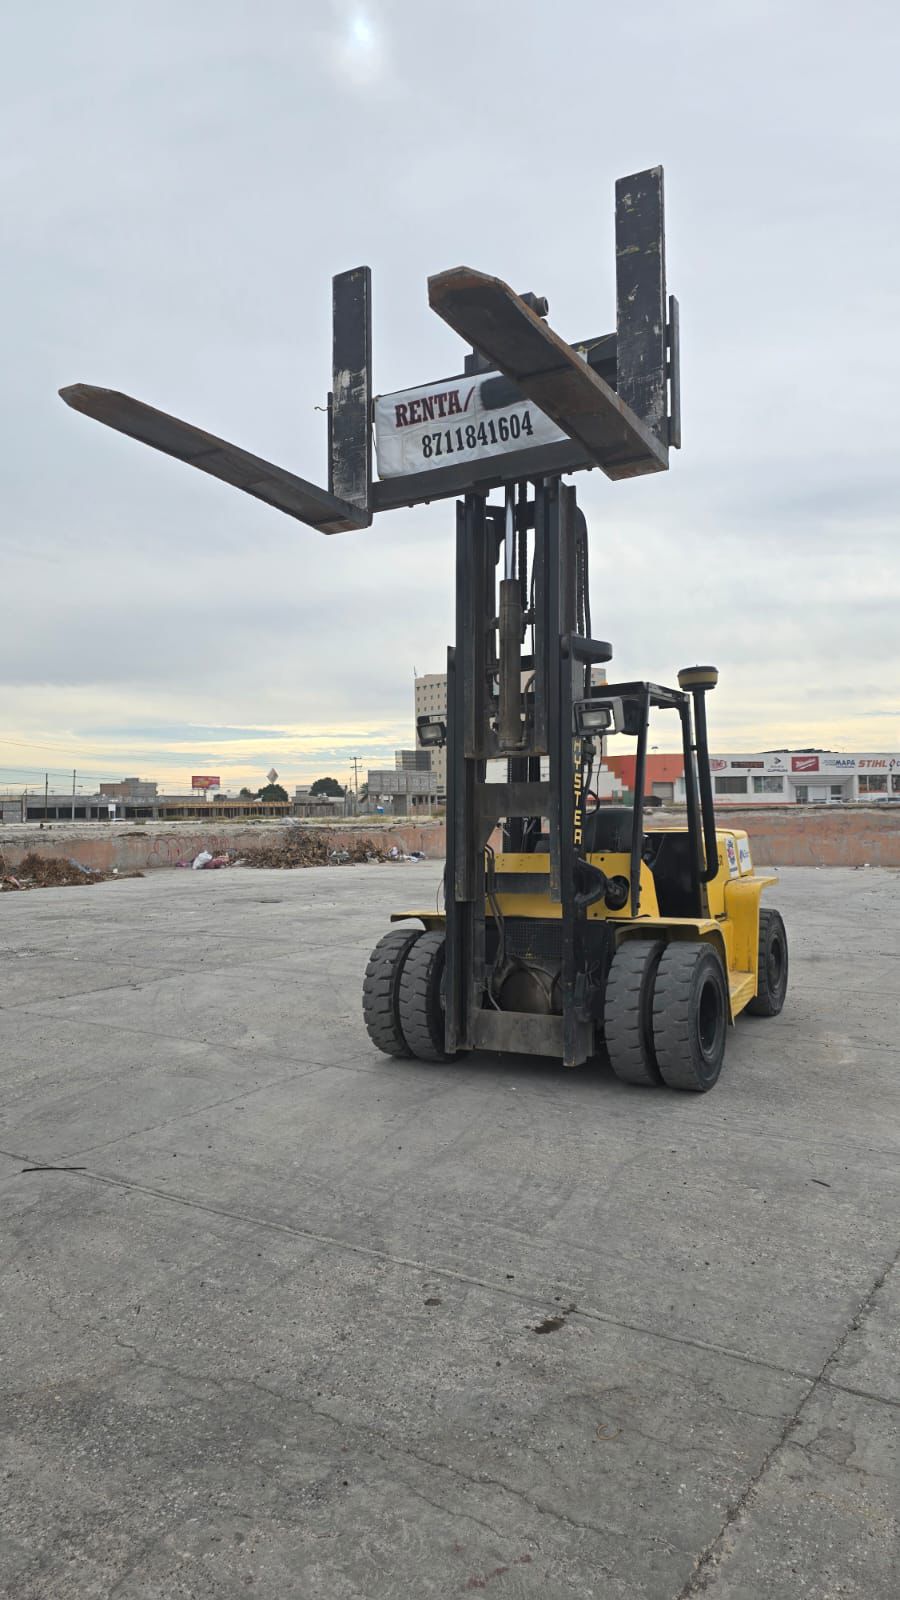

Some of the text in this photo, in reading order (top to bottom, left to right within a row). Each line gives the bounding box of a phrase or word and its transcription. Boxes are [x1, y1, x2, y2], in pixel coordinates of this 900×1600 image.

[422, 411, 533, 458] 8711841604
[858, 759, 887, 768] STIHL
[573, 740, 582, 844] HYSTER
